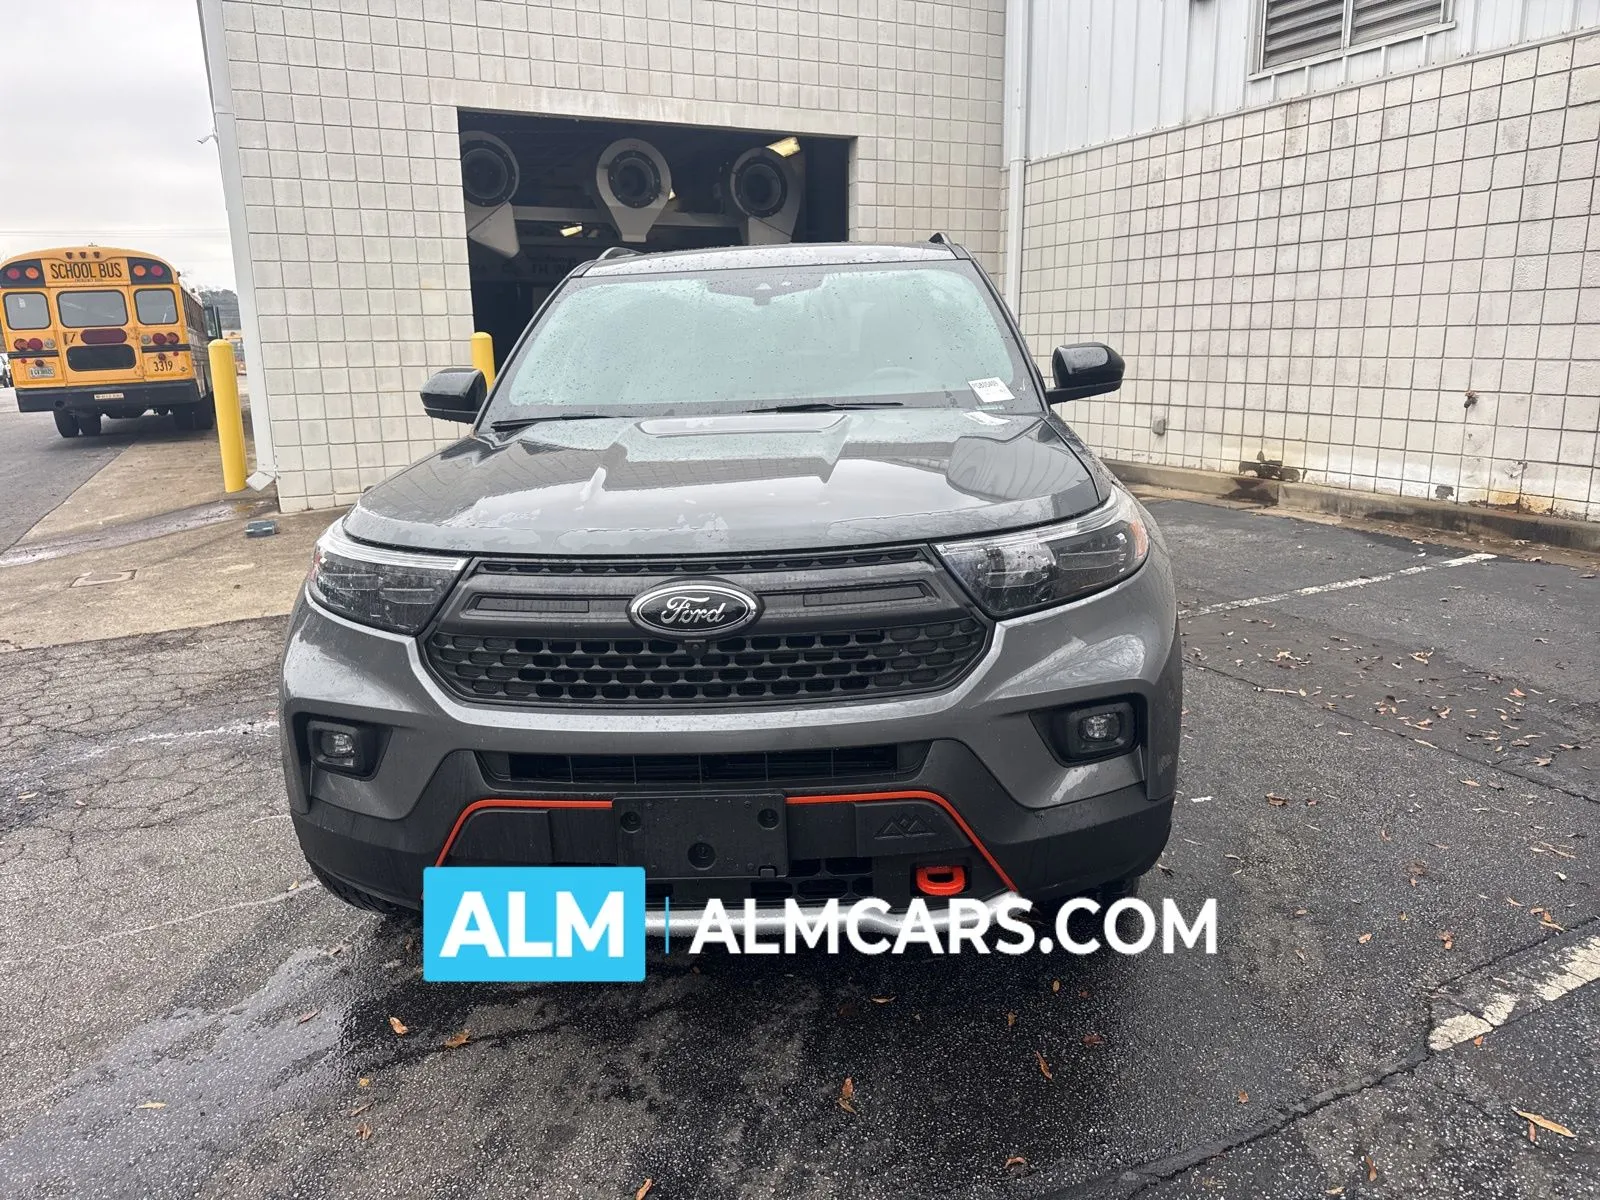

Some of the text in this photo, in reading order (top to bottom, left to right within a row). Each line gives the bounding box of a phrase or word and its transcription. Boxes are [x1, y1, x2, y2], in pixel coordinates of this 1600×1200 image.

[50, 263, 122, 279] SCHOOL BUS
[153, 360, 173, 372] 3319
[660, 596, 727, 624] Ford
